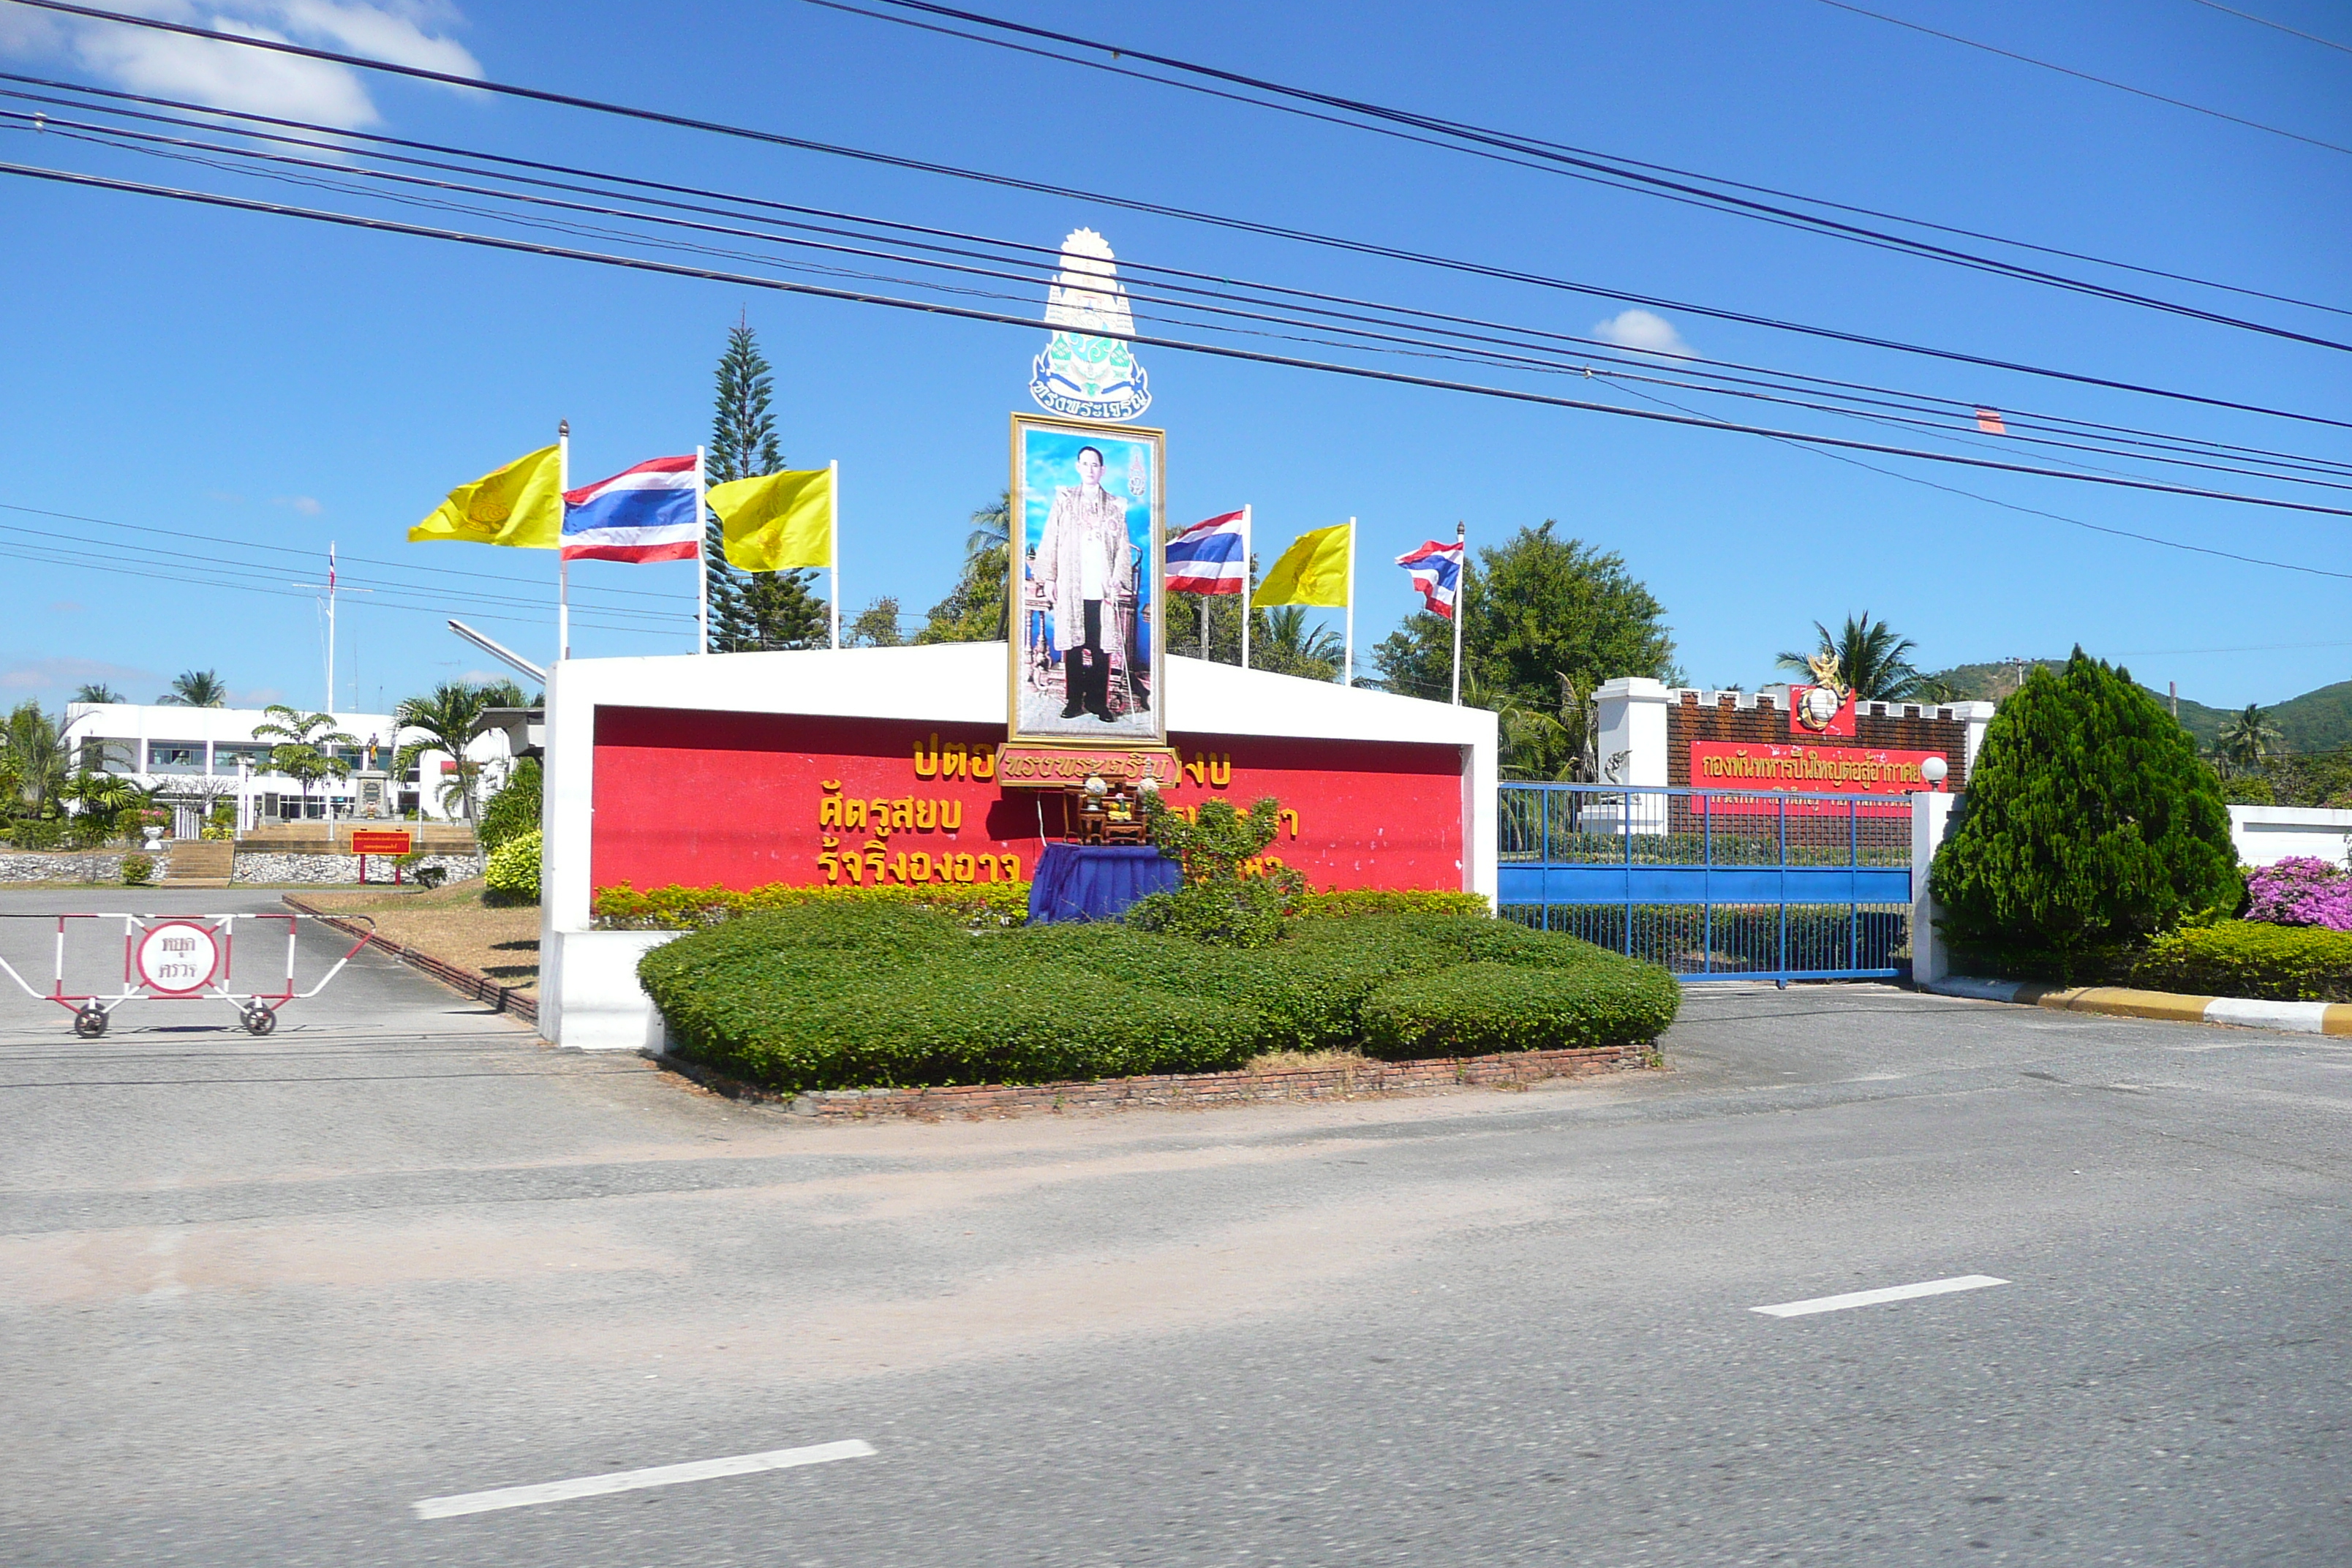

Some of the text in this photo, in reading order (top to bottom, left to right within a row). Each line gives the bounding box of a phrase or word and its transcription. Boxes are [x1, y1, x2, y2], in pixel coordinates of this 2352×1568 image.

[1702, 750, 1929, 790] กองพันทหารปืนใหญ่ต่อสู้อากาศย
[820, 780, 962, 837] ศัตรูสยบ
[818, 836, 1021, 886] ร้จริงองอาจ
[162, 937, 196, 959] หยุด
[158, 963, 198, 979] ตรวจ
